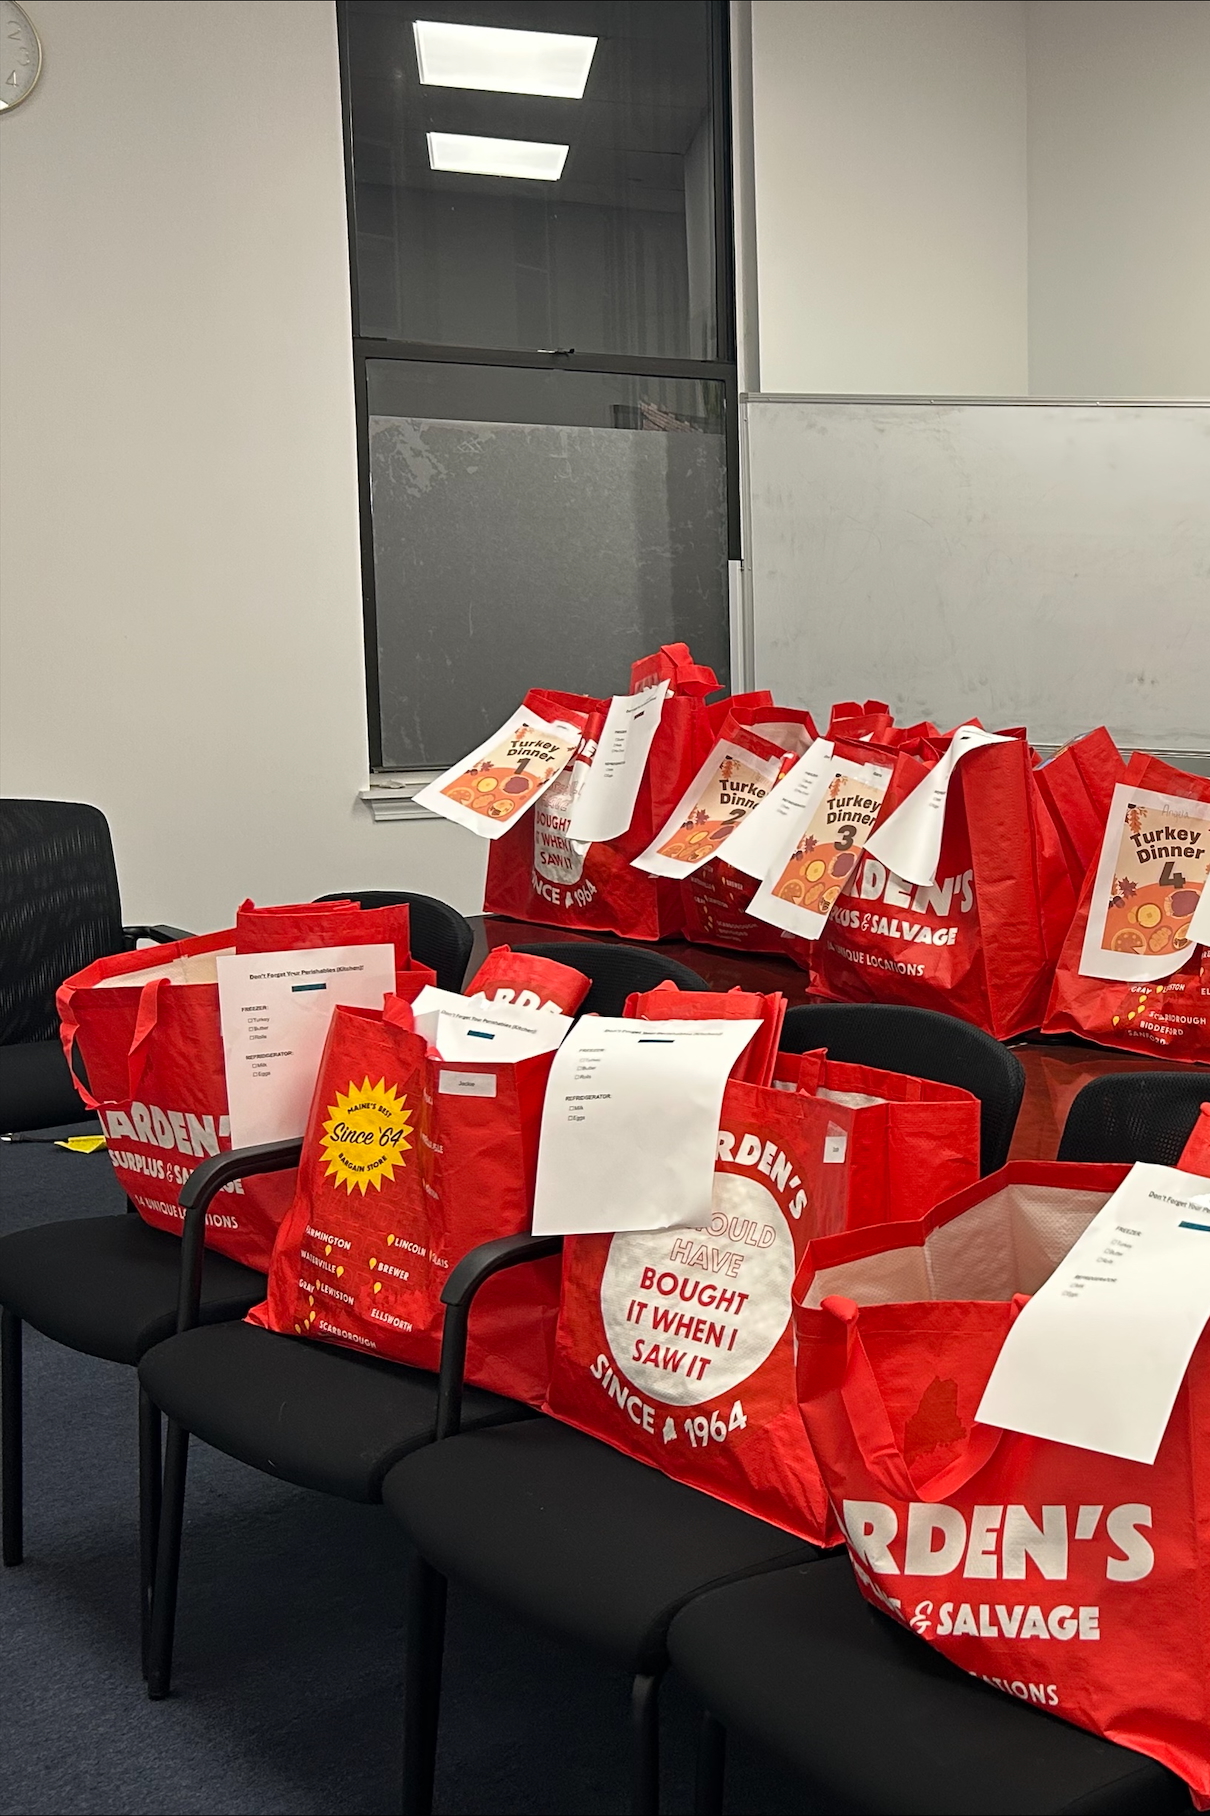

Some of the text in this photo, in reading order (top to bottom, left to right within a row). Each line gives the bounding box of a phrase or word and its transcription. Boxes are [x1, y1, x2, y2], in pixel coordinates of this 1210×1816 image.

[506, 747, 556, 762] Dinner
[510, 740, 561, 753] Turkey
[513, 758, 531, 775] 1
[719, 779, 770, 799] Turke
[720, 792, 760, 810] Dinn
[826, 794, 881, 813] Turkey
[720, 808, 747, 825] 2
[826, 809, 877, 827] Dinner
[834, 824, 857, 851] 3
[1130, 826, 1202, 848] Turkey
[1136, 845, 1206, 864] Dinner
[1158, 861, 1186, 889] 4
[531, 870, 598, 908] INCE 1964
[861, 912, 872, 932] &
[870, 914, 959, 946] SALVAGE
[835, 944, 865, 965] UNIQUE
[866, 953, 926, 977] LOCATIONS
[250, 973, 267, 981] Don't
[266, 971, 286, 979] Forget
[287, 970, 300, 978] Your
[301, 967, 336, 976] Perishables
[1130, 985, 1153, 995] GRAY
[241, 1005, 268, 1013] FREEZER:
[1148, 1010, 1207, 1025] SCARBOROUGH
[1140, 1020, 1184, 1036] BIDDEFORD
[347, 1102, 392, 1118] MAINE'S BEST
[330, 1122, 375, 1145] Since
[109, 1149, 165, 1180] SURPLUS
[166, 1162, 174, 1183] &
[338, 1152, 388, 1172] BARGAIN STORE
[144, 1197, 178, 1218] UNIQUE
[1148, 1190, 1167, 1202] Don't
[1167, 1194, 1188, 1209] Forget
[394, 1237, 427, 1257] LINCOLN
[300, 1249, 337, 1274] WATERVILLE
[669, 1238, 745, 1279] HAVE
[377, 1262, 410, 1282] BREWER
[298, 1278, 315, 1294] GRAY
[320, 1282, 354, 1306] LEWISTON
[639, 1266, 750, 1316] BOUGHT
[370, 1308, 413, 1333] ELLSWORTH
[626, 1299, 739, 1352] IT WHEN I
[318, 1320, 377, 1349] SCARBOROUGH
[632, 1338, 712, 1381] SAW IT
[589, 1353, 748, 1448] SINCE 1964
[909, 1600, 1101, 1641] & SALVAGE
